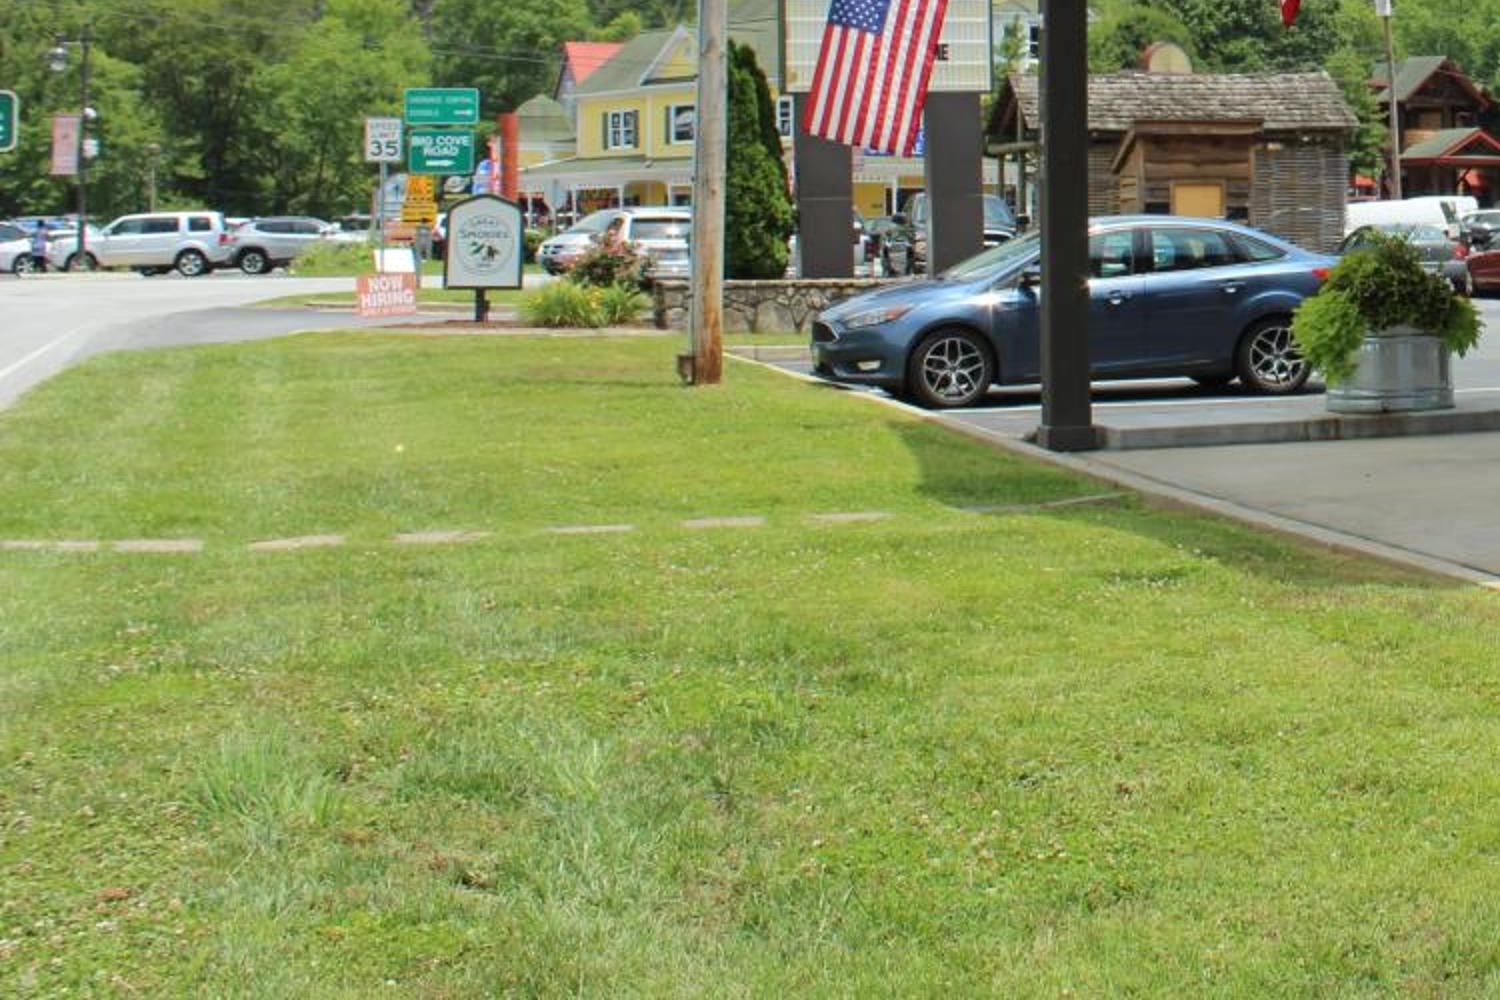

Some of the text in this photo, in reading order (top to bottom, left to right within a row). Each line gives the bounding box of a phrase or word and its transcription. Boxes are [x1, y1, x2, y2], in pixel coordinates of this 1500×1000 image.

[370, 140, 399, 157] 35
[411, 135, 471, 146] BIG COVE
[423, 146, 459, 157] ROAD
[368, 275, 402, 292] NOW
[360, 290, 415, 308] HIRING
